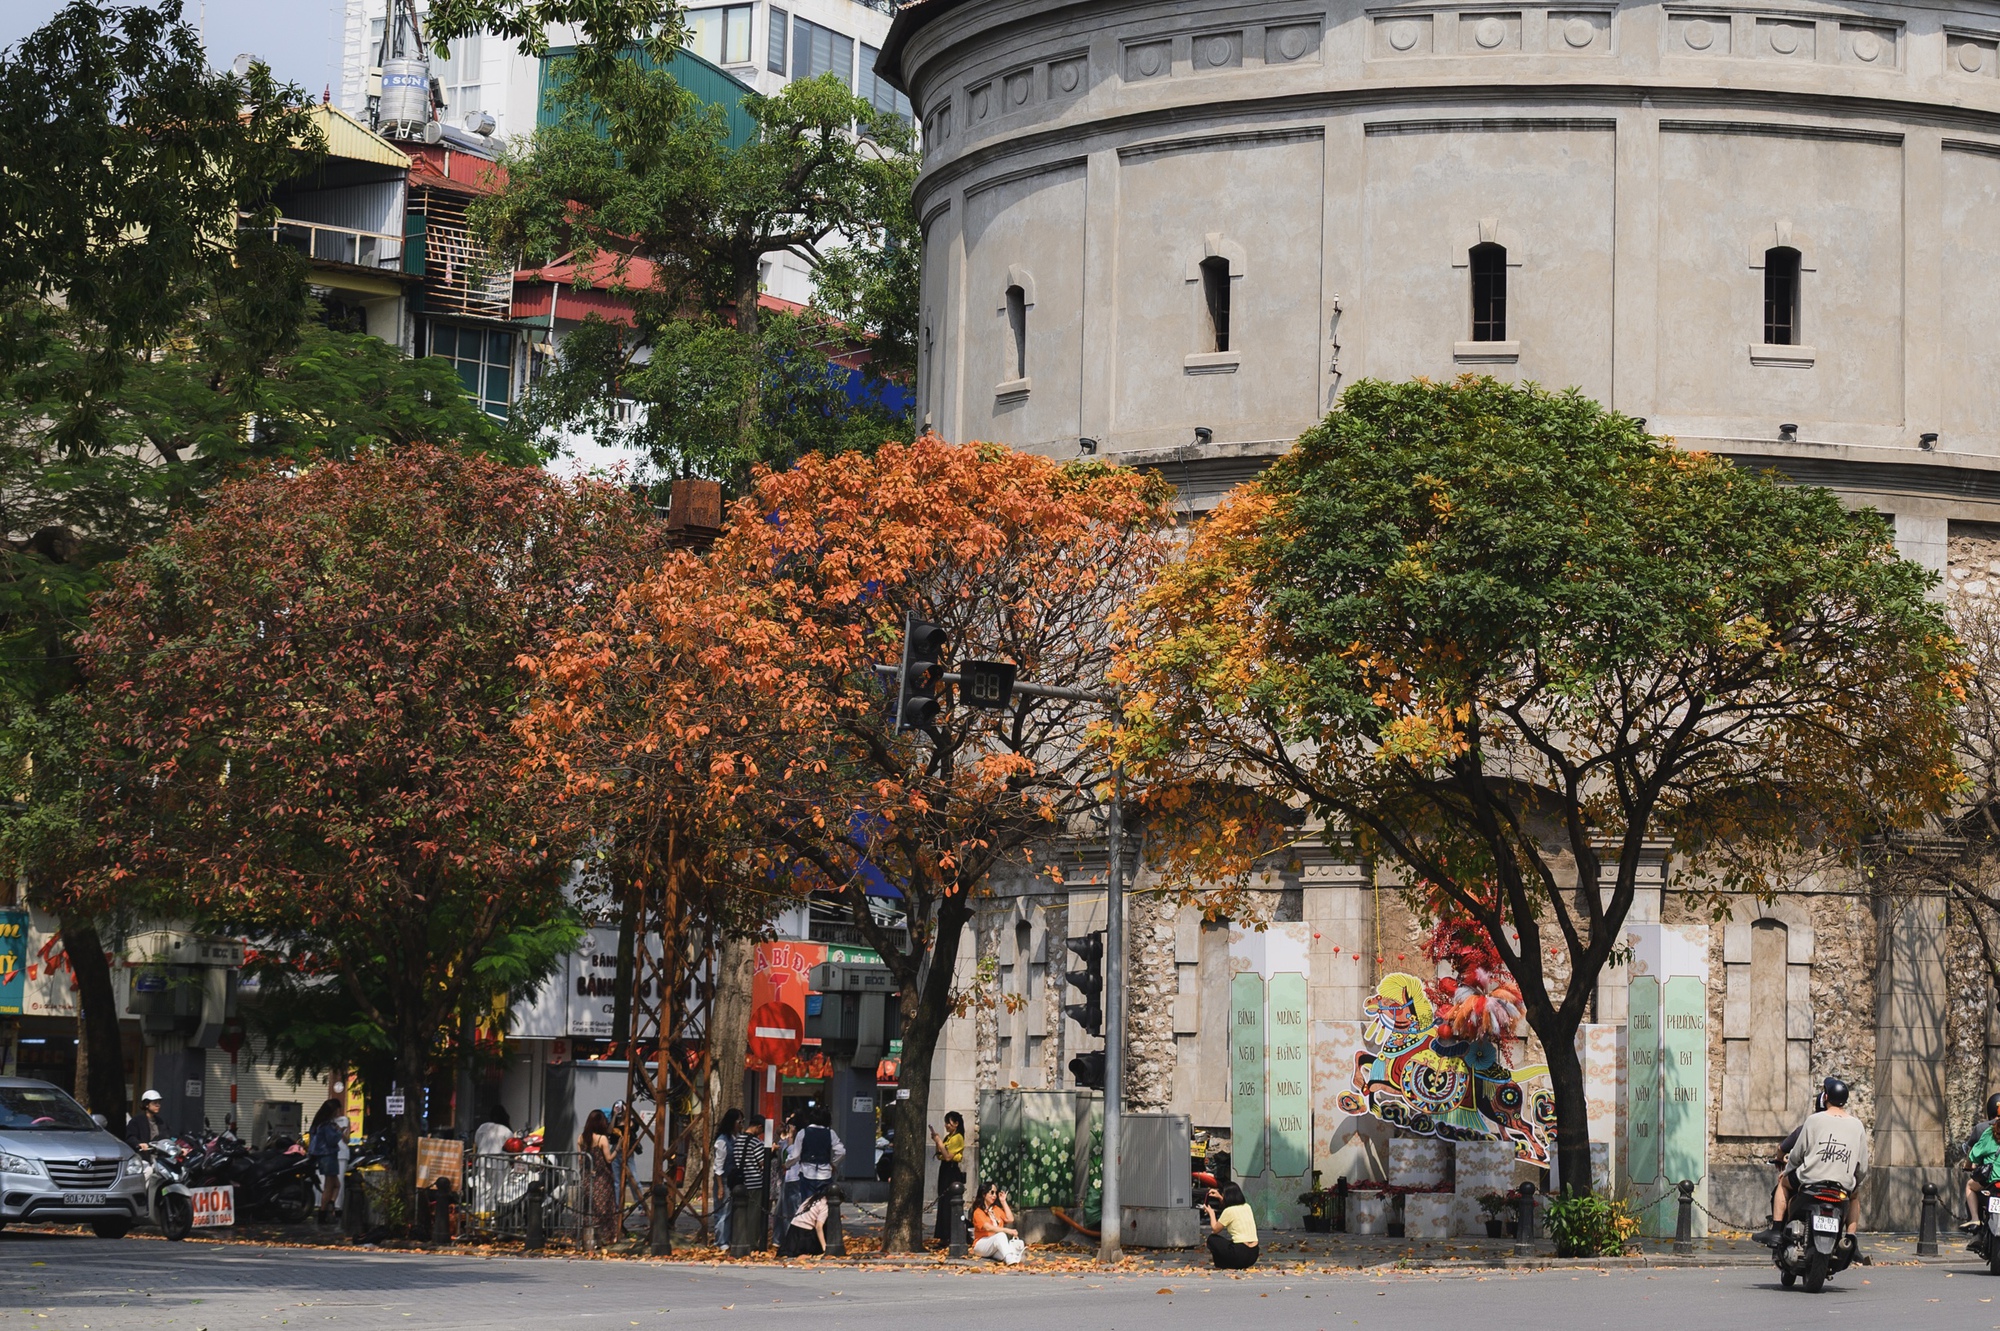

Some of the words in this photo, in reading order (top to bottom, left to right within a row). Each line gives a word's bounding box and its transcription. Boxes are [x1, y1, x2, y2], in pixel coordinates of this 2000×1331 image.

[772, 944, 790, 967] BÍ
[1238, 1008, 1255, 1025] BÍNH
[1277, 1008, 1302, 1025] MỪNG
[1634, 1012, 1651, 1029] CHÚC
[1667, 1013, 1704, 1029] PHƯỜNG
[1239, 1046, 1255, 1062] NGỌ
[1276, 1043, 1302, 1060] ĐẢNG
[1633, 1048, 1651, 1065] MỪNG
[1680, 1051, 1692, 1065] BA
[1239, 1082, 1255, 1096] 2026
[1277, 1079, 1302, 1096] MỪNG
[1635, 1085, 1649, 1101] NĂM
[1674, 1085, 1697, 1101] ĐÌNH
[1279, 1115, 1302, 1131] XUÂN
